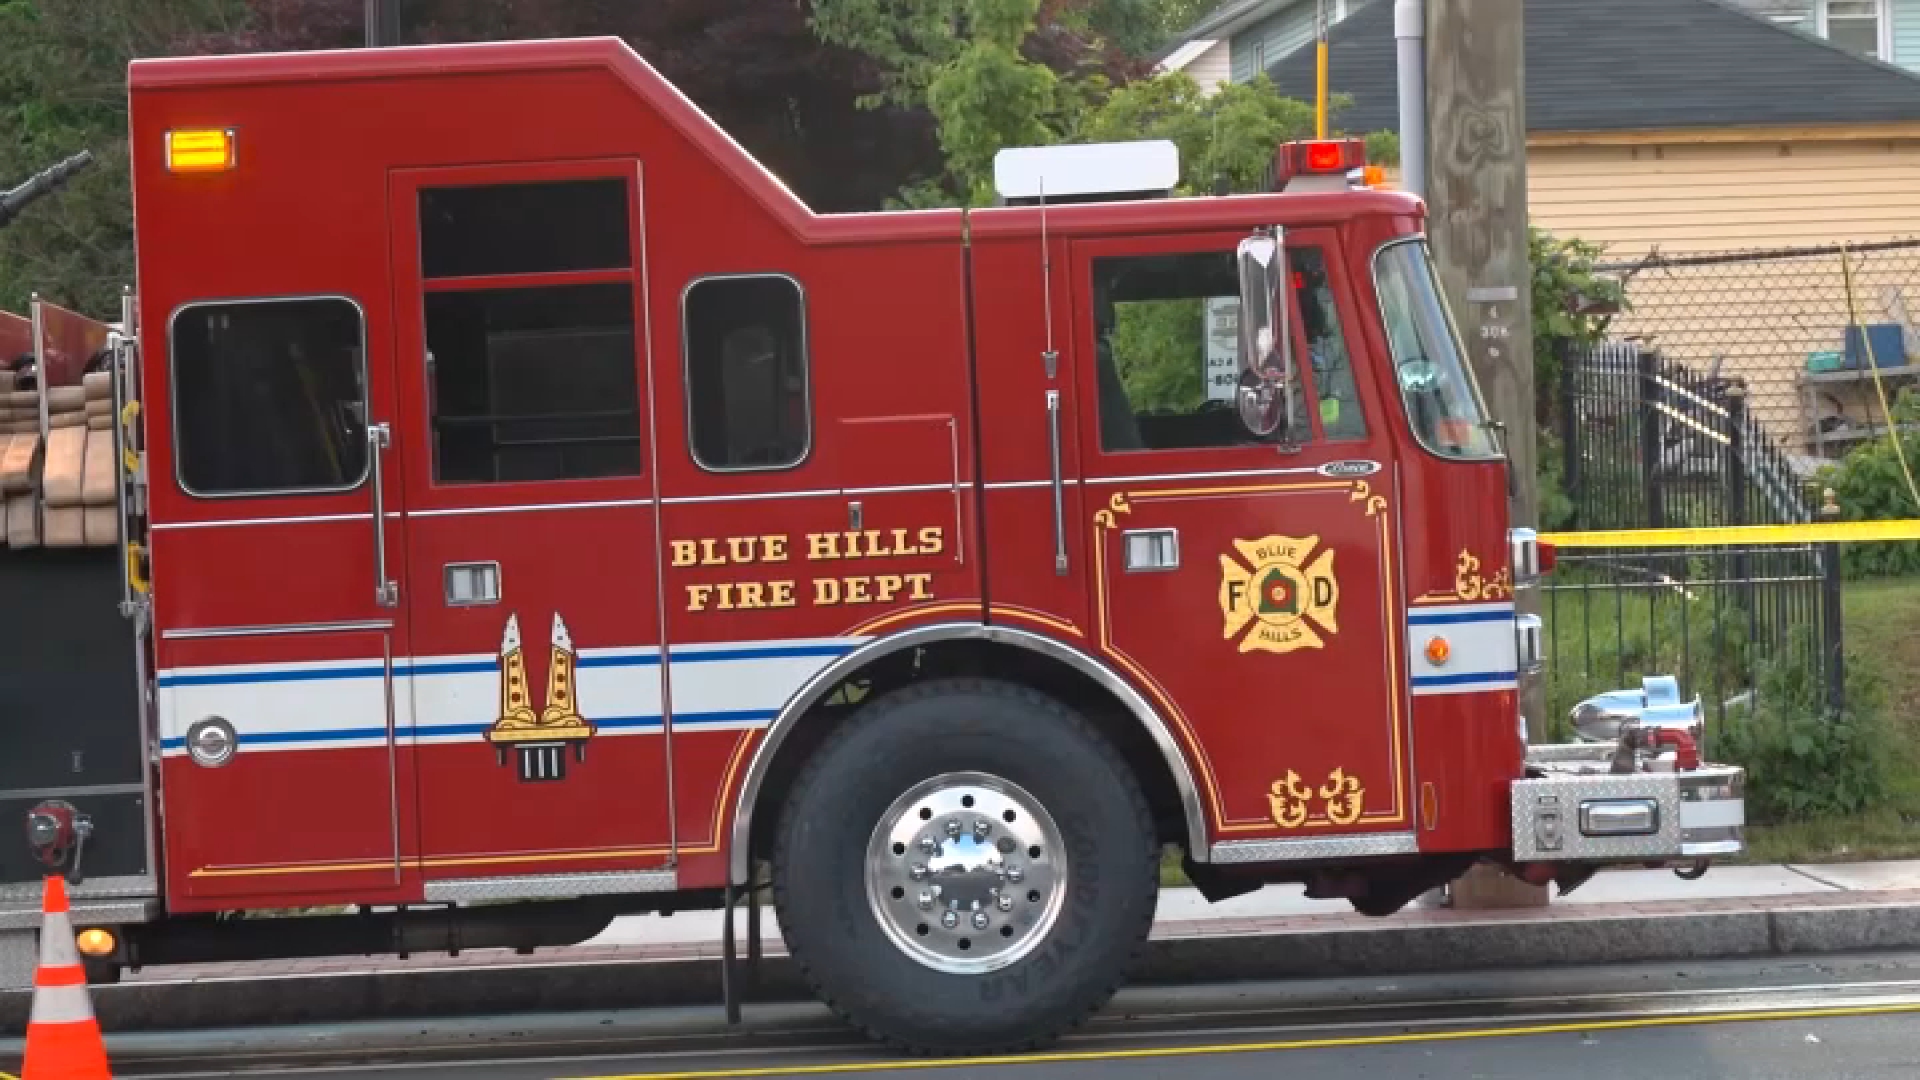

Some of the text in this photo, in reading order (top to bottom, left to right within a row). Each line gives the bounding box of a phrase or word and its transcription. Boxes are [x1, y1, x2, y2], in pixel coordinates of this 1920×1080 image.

[670, 526, 944, 567] BLUE HILLS
[1256, 545, 1297, 560] BLUE
[685, 573, 935, 611] FIRE DEPT
[1228, 576, 1332, 612] F D
[1259, 628, 1302, 643] HILLS
